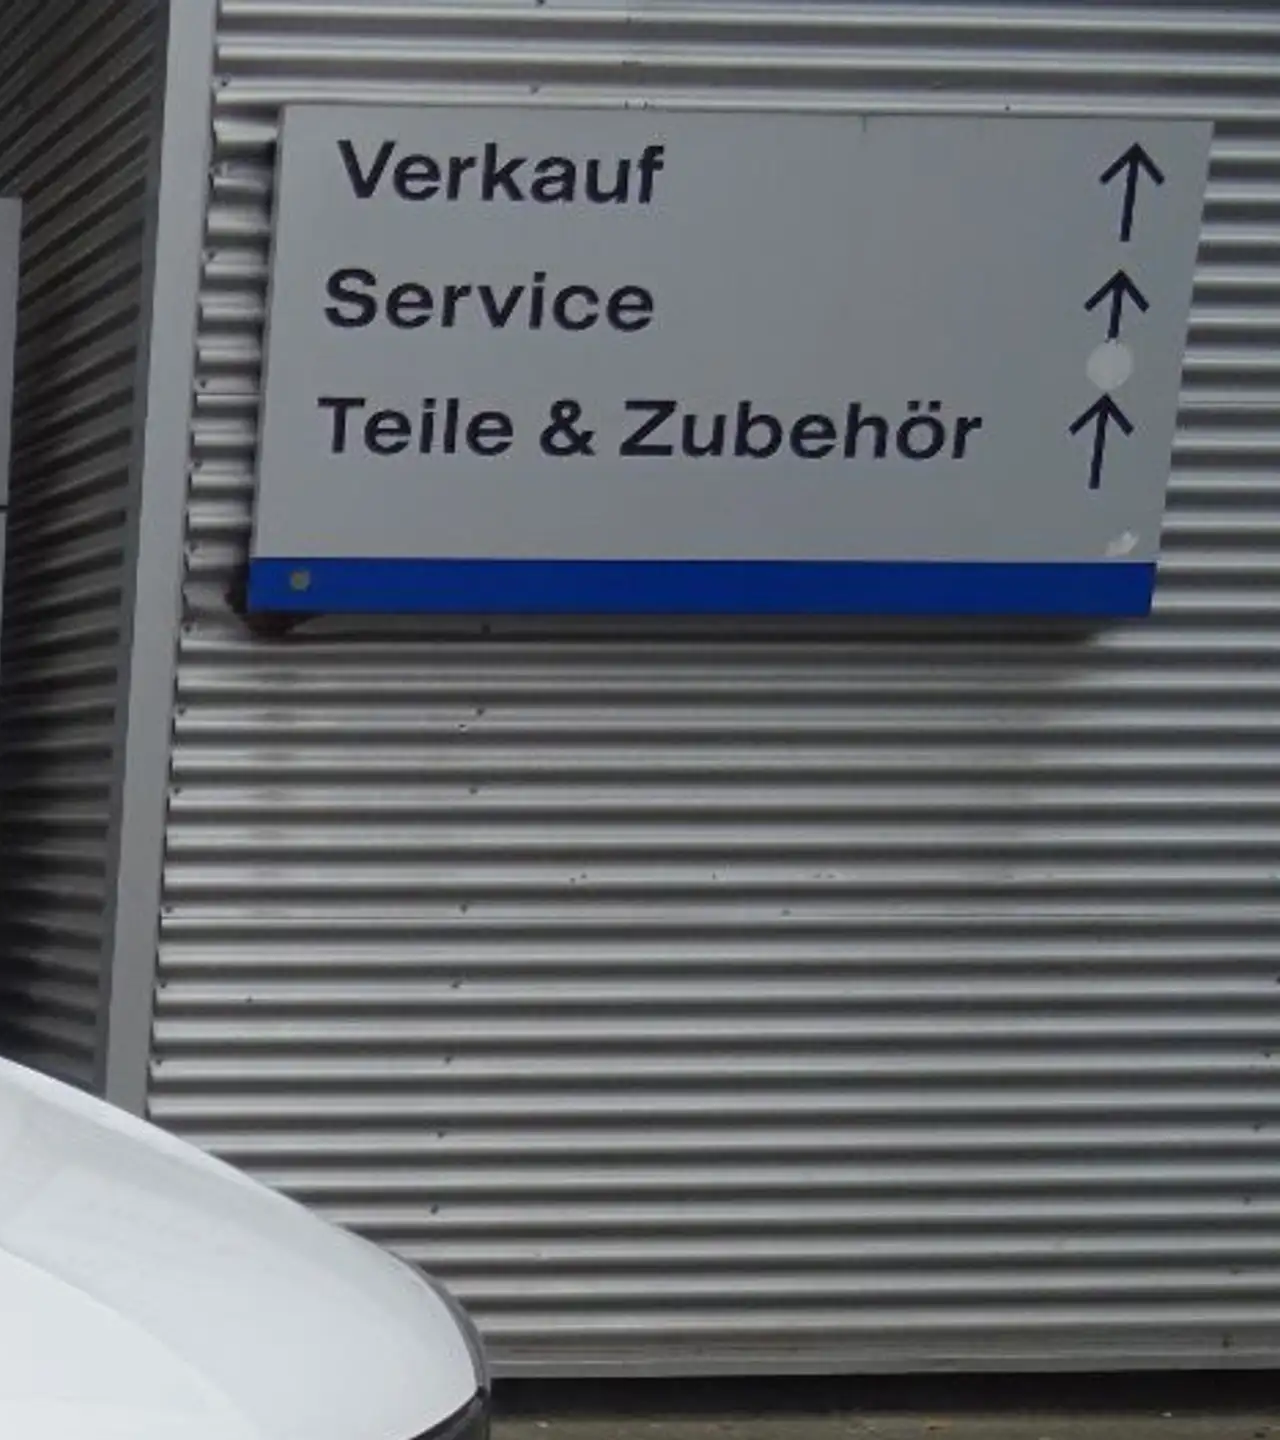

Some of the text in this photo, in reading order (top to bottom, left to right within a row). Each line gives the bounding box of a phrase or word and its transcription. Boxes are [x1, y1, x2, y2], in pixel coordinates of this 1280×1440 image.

[336, 138, 666, 205] Verkauf
[323, 267, 655, 334] Service
[316, 397, 984, 461] Teile & Zubehör
